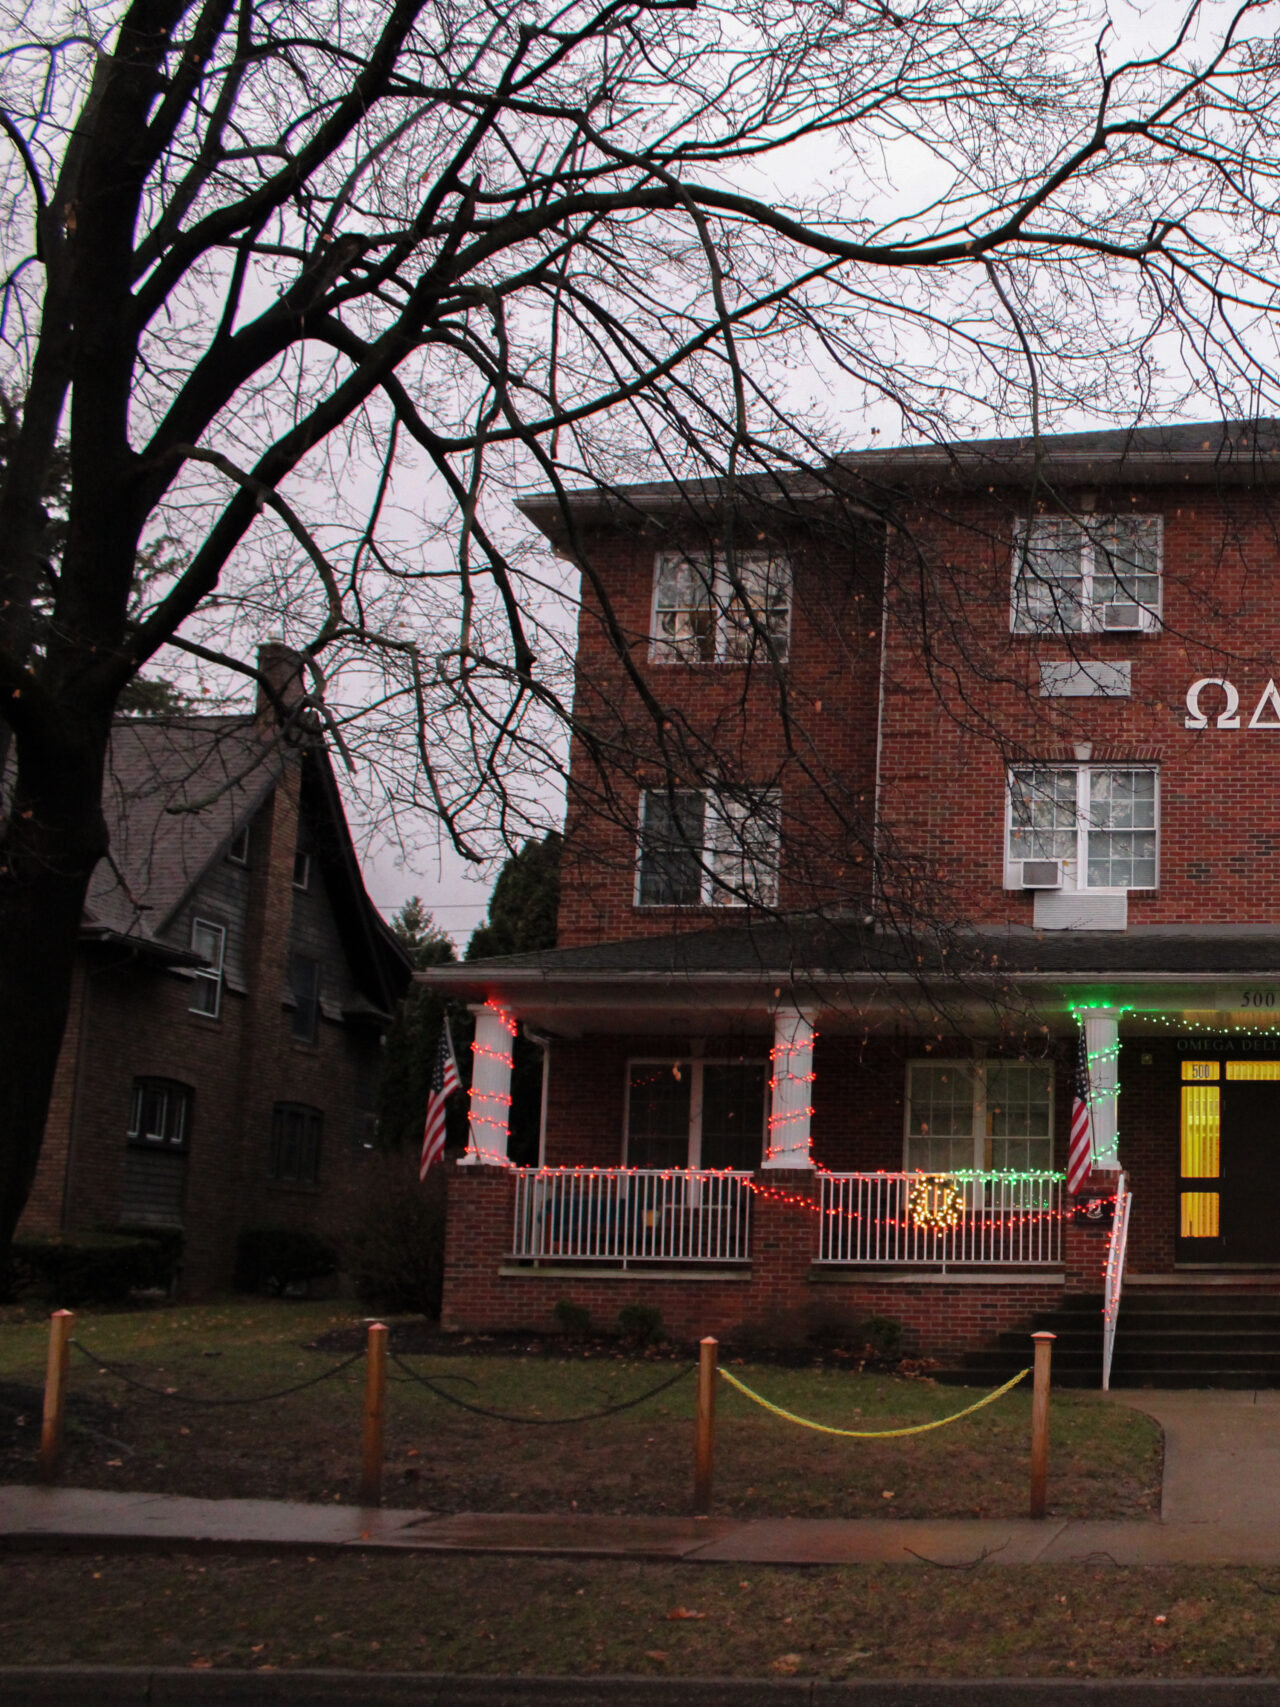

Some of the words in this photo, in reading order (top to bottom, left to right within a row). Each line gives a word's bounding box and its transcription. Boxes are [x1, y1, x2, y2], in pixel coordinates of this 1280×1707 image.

[1240, 991, 1276, 1008] 500
[1177, 1039, 1234, 1050] OMEGA
[1192, 1064, 1210, 1079] 500
